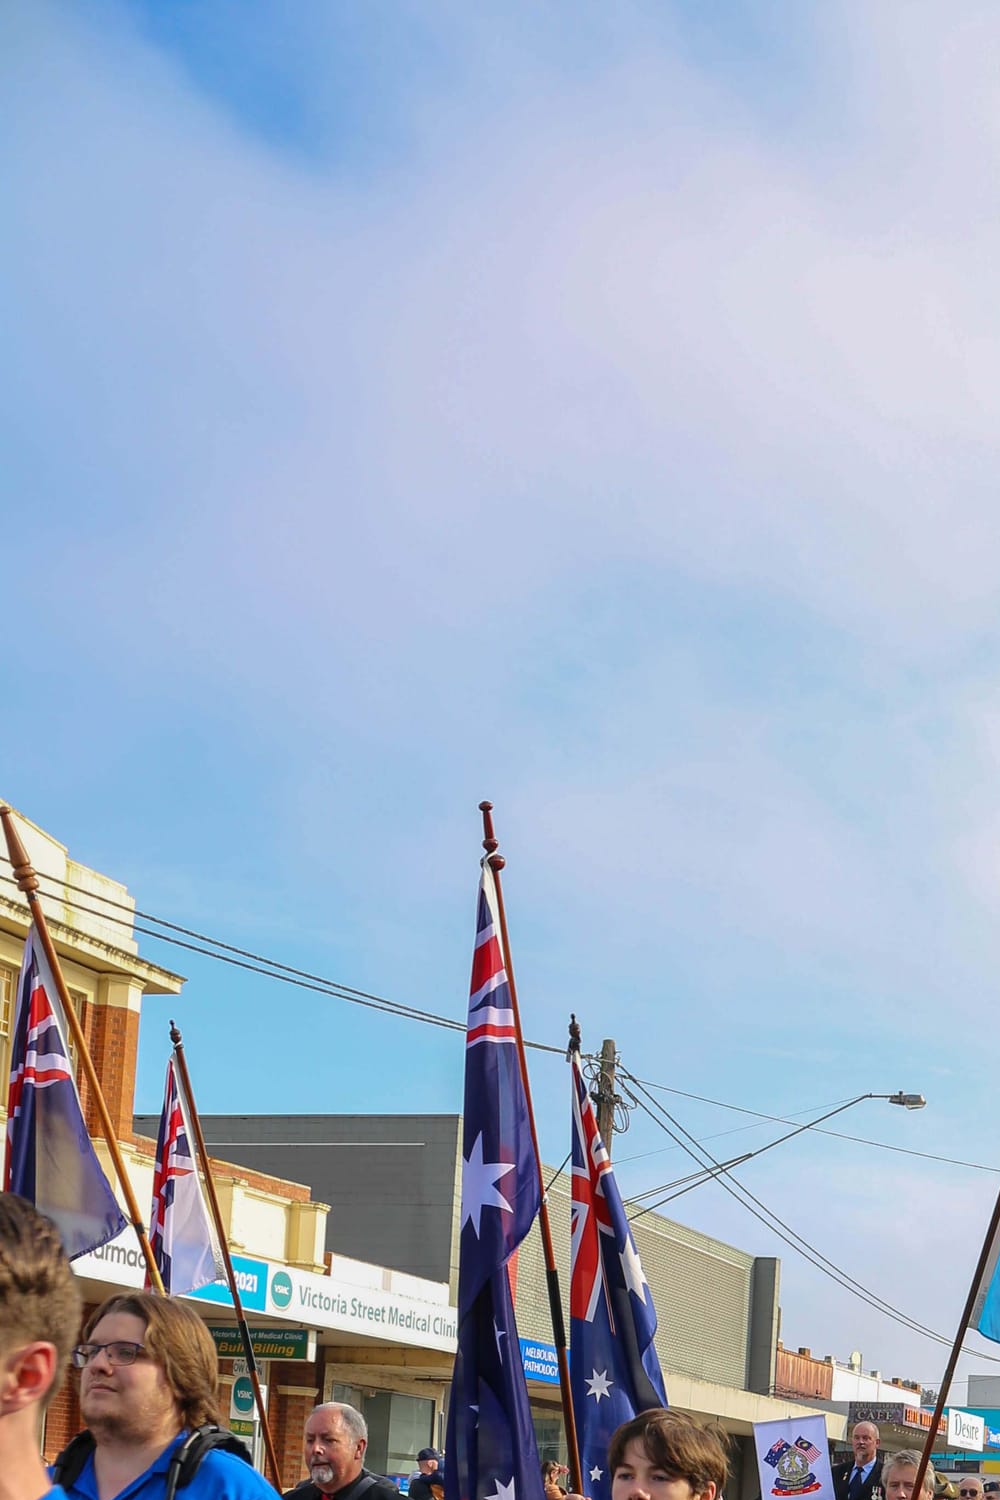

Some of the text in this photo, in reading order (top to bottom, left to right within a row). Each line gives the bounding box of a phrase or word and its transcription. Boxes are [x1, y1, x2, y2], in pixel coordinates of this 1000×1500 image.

[89, 1244, 147, 1269] armac
[299, 1285, 459, 1339] Victoria Street Medical Clini
[219, 1342, 295, 1356] Bul Billing
[525, 1346, 558, 1363] MELBOURN
[524, 1360, 559, 1377] PATHOLOGY
[857, 1411, 894, 1421] CAFE
[955, 1413, 980, 1440] Desire
